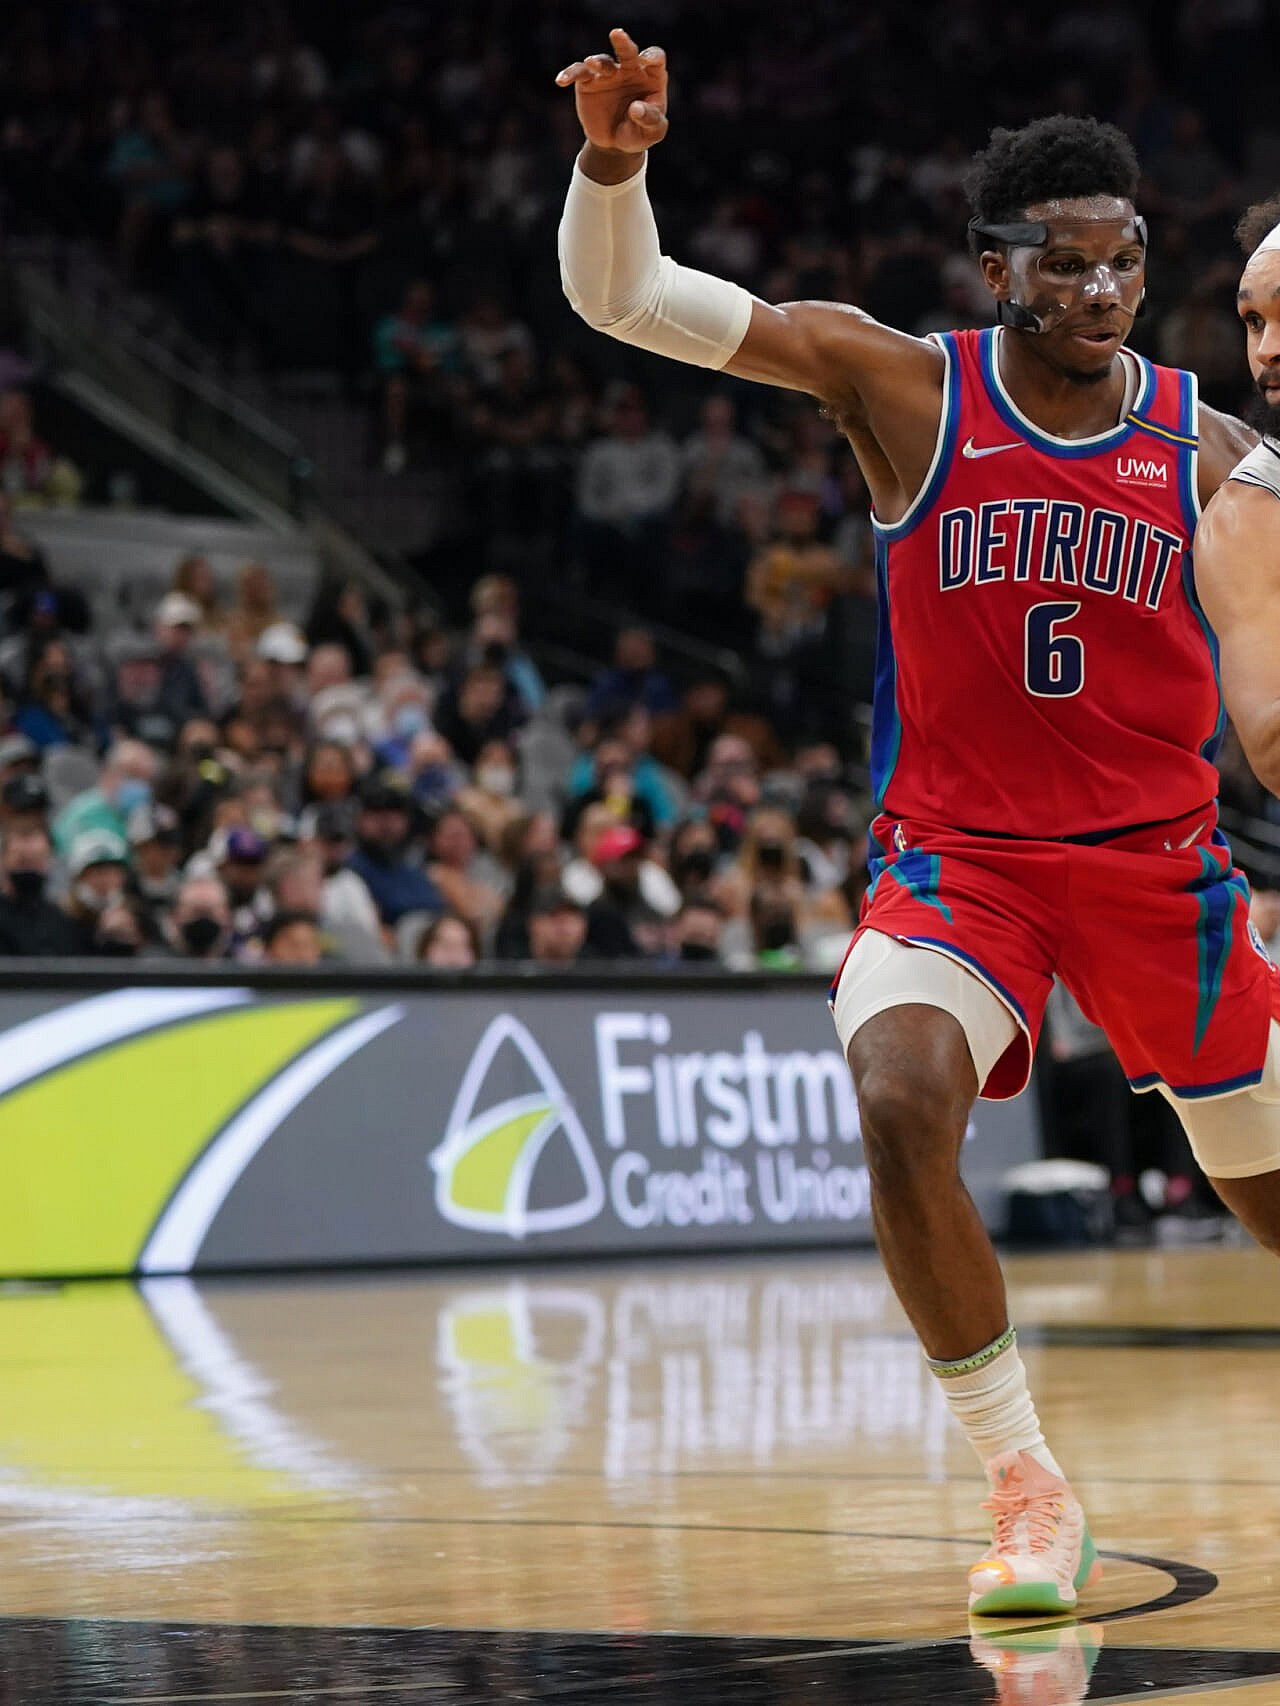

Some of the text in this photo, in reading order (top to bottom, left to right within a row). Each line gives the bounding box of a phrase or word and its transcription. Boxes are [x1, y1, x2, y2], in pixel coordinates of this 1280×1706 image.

[1116, 457, 1168, 482] UWM
[939, 498, 1184, 612] DETROIT
[1024, 601, 1085, 699] 6
[595, 1012, 862, 1148] Firstm
[610, 1150, 755, 1229] Credit
